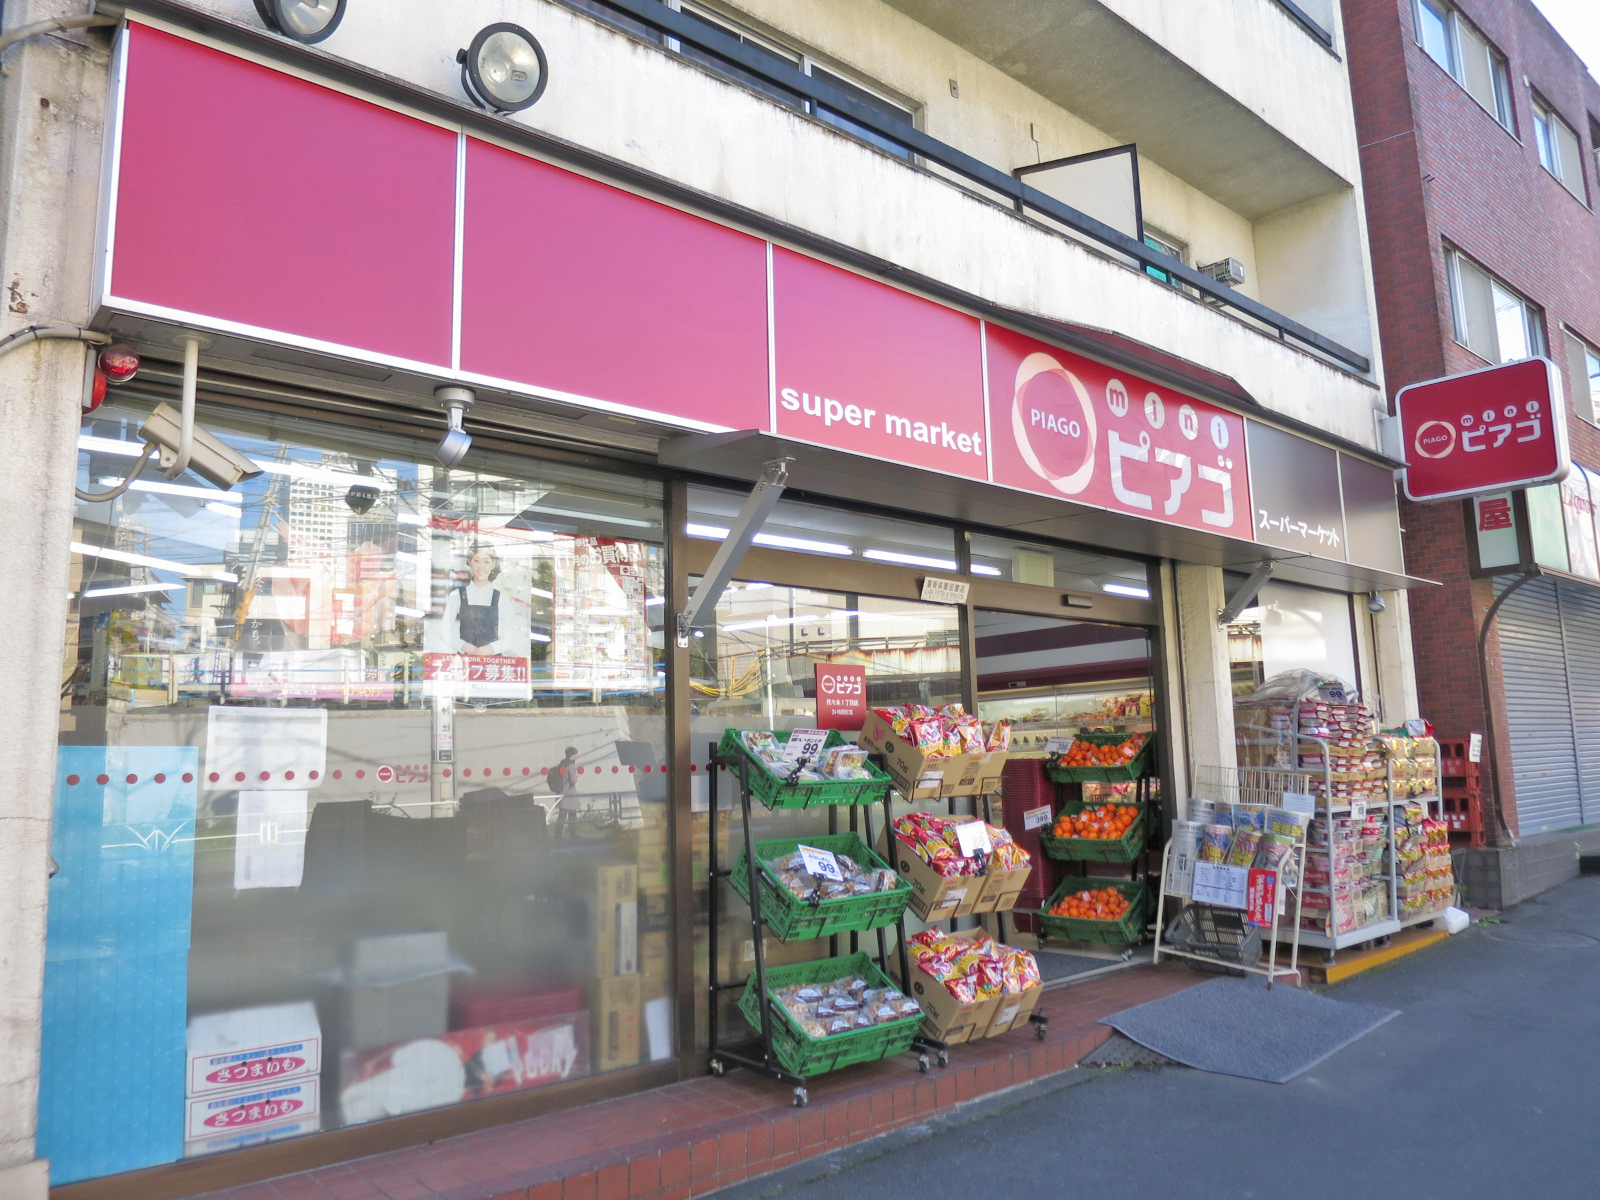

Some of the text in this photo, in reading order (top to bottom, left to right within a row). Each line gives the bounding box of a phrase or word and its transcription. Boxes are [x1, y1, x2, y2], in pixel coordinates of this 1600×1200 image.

[781, 387, 983, 457] super market
[1030, 408, 1081, 438] PIAGO
[1107, 382, 1226, 449] mini
[1461, 402, 1538, 425] mini
[1422, 434, 1448, 445] PIAGO
[1461, 413, 1542, 453] ピアゴ
[1107, 429, 1234, 528] ピアゴ
[1478, 498, 1512, 532] 屋
[1258, 509, 1341, 548] スーパーマーケット
[483, 657, 516, 665] TOGETHER
[836, 682, 862, 695] ピアゴ
[1329, 690, 1343, 698] 99
[801, 742, 819, 755] 99
[818, 861, 836, 874] 99
[216, 1058, 296, 1083] さつまいも
[214, 1100, 294, 1127] さつまいも
